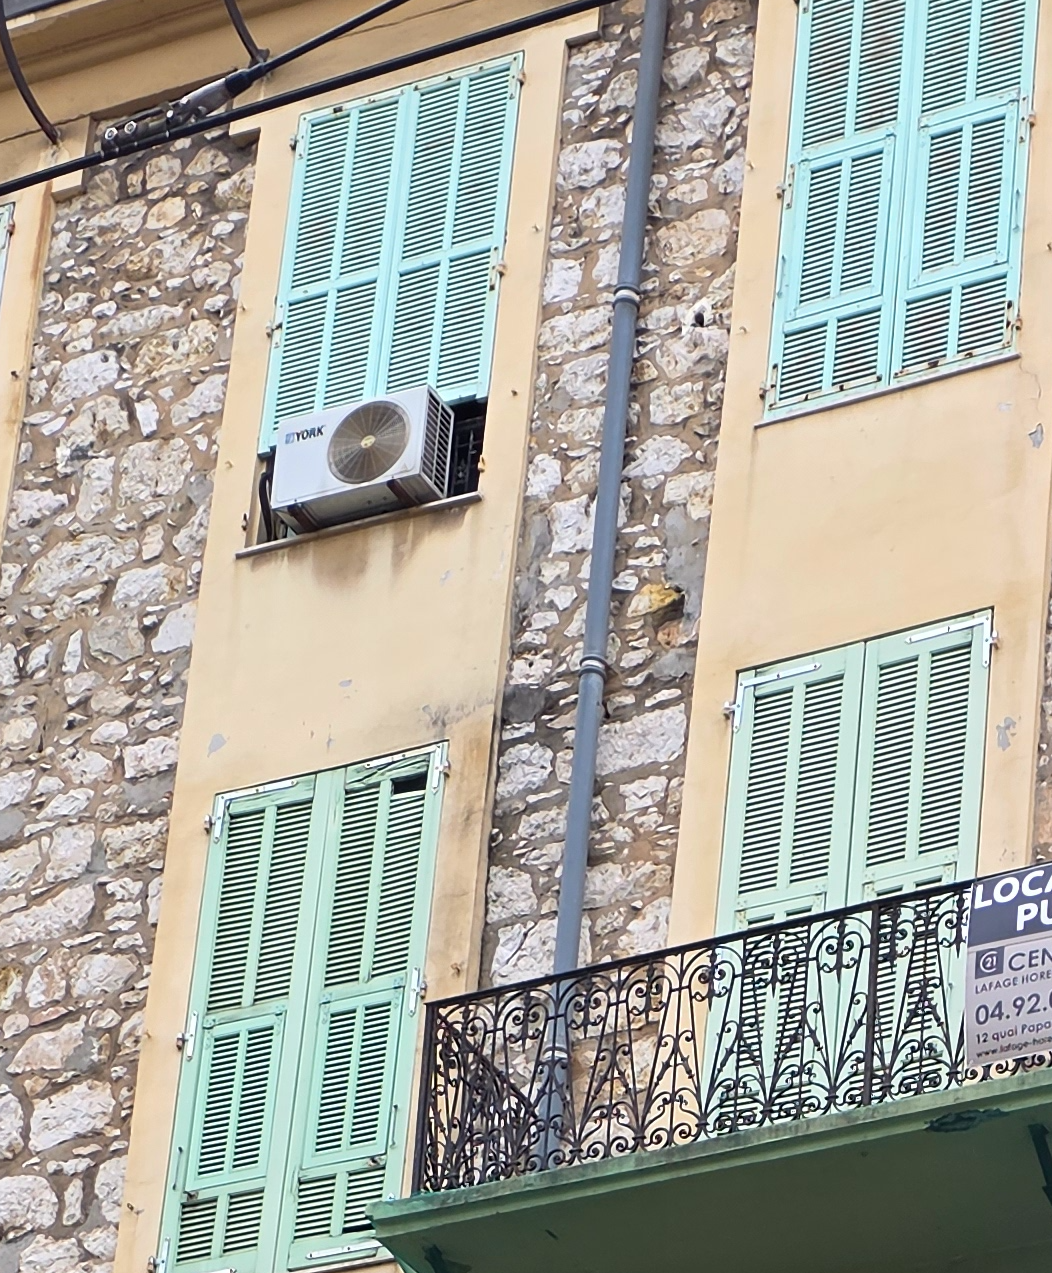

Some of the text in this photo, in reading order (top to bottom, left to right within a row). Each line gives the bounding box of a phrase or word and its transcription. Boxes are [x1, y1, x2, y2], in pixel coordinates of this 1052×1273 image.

[295, 425, 326, 442] YORK
[974, 977, 1019, 995] LAFAGE
[975, 1033, 989, 1045] 12
[991, 1026, 1018, 1043] quai
